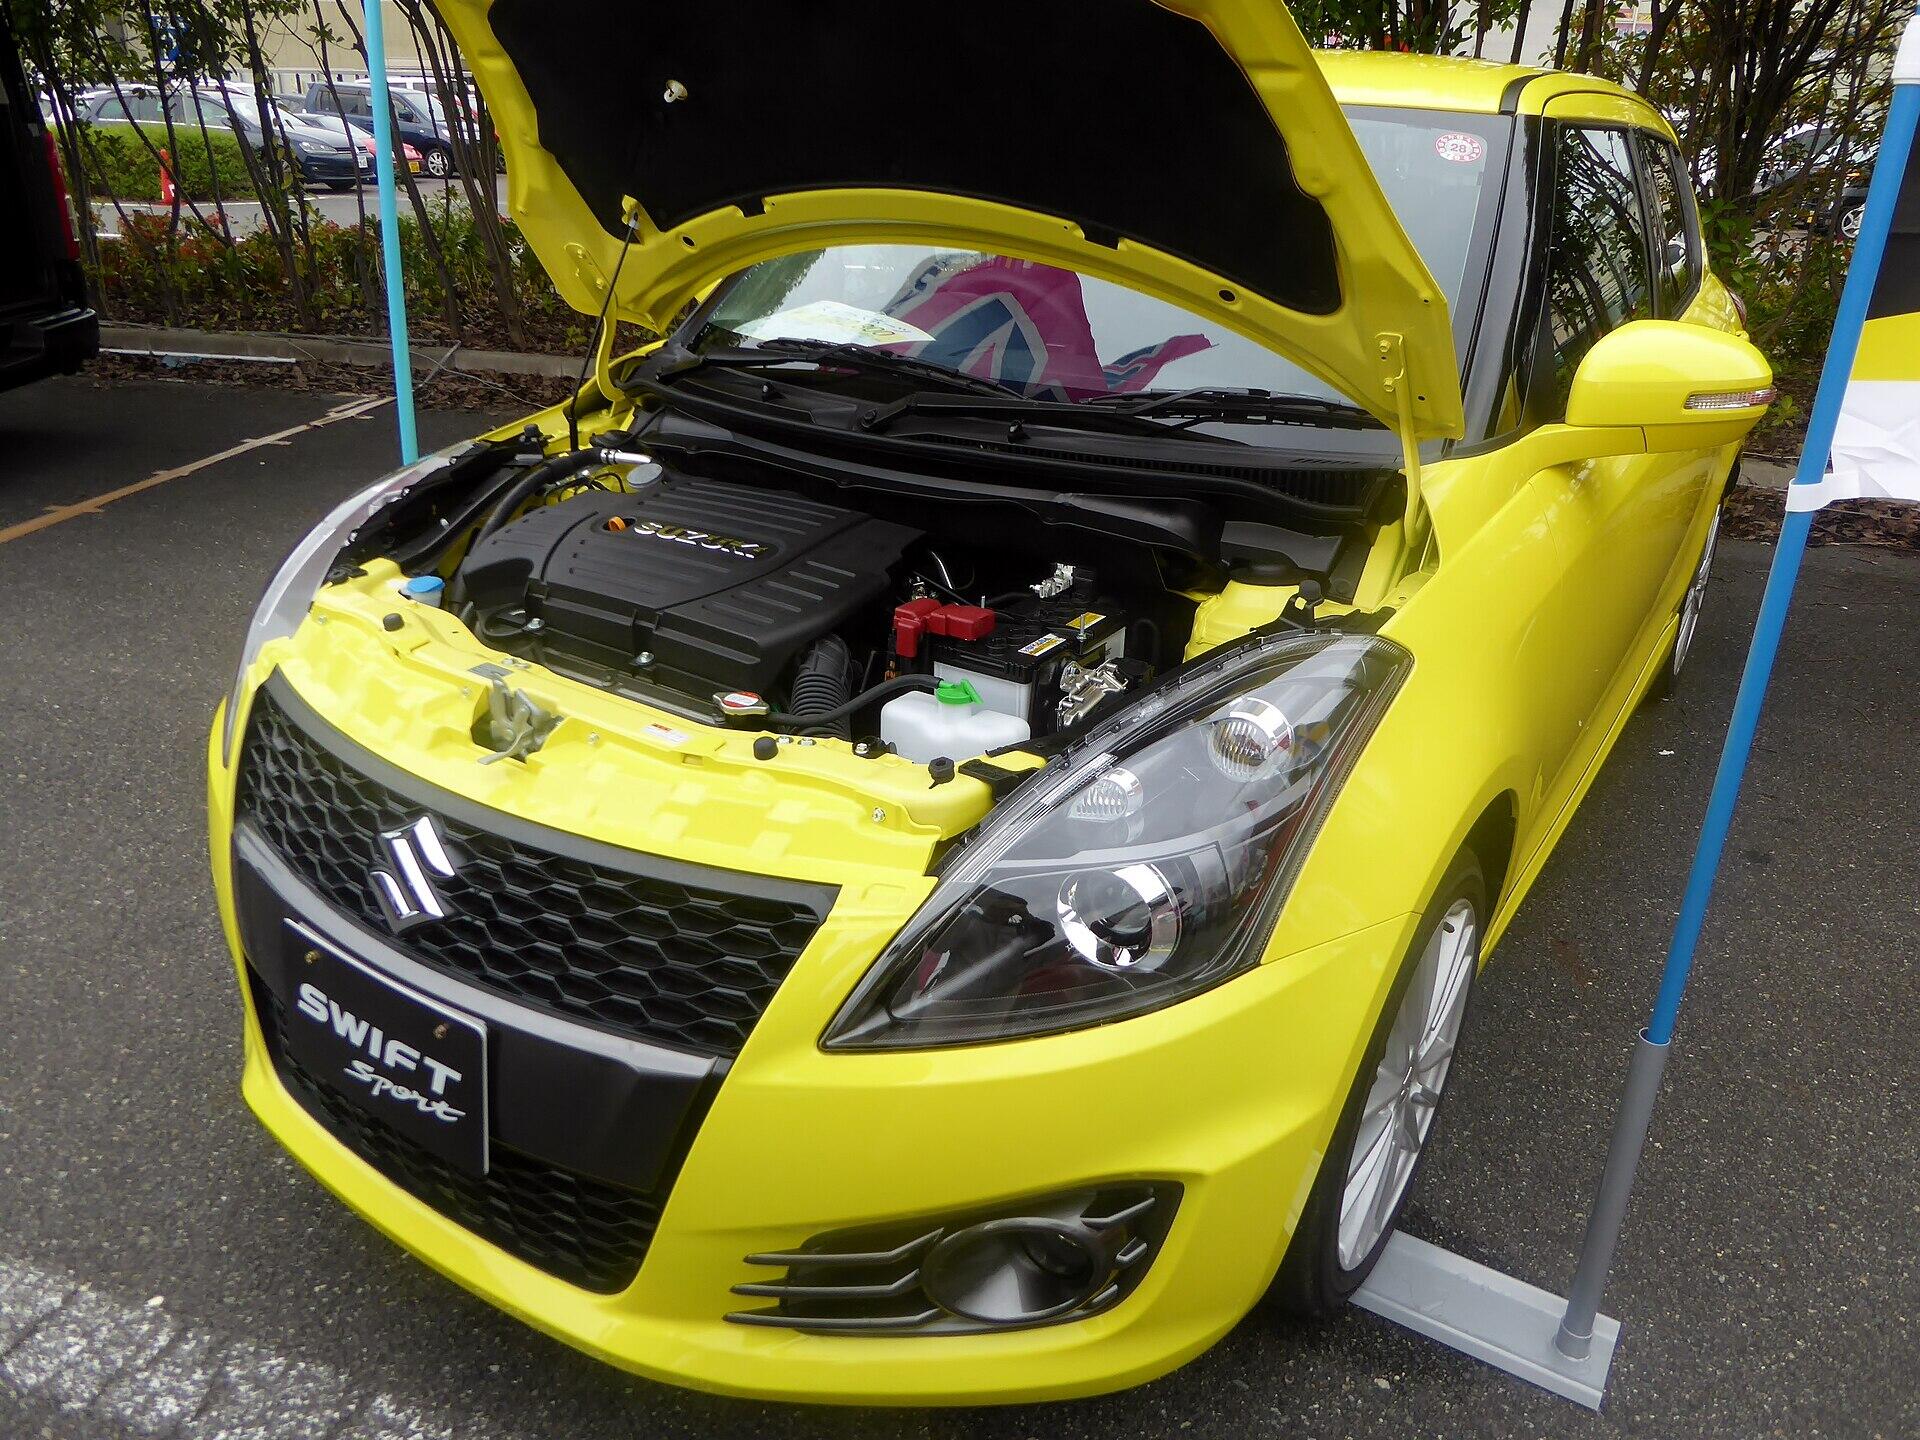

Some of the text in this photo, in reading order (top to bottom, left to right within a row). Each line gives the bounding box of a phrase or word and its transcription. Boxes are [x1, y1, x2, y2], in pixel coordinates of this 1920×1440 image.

[634, 521, 769, 559] SUZUKI
[297, 982, 463, 1096] SWIFT
[343, 1059, 466, 1123] Sport
